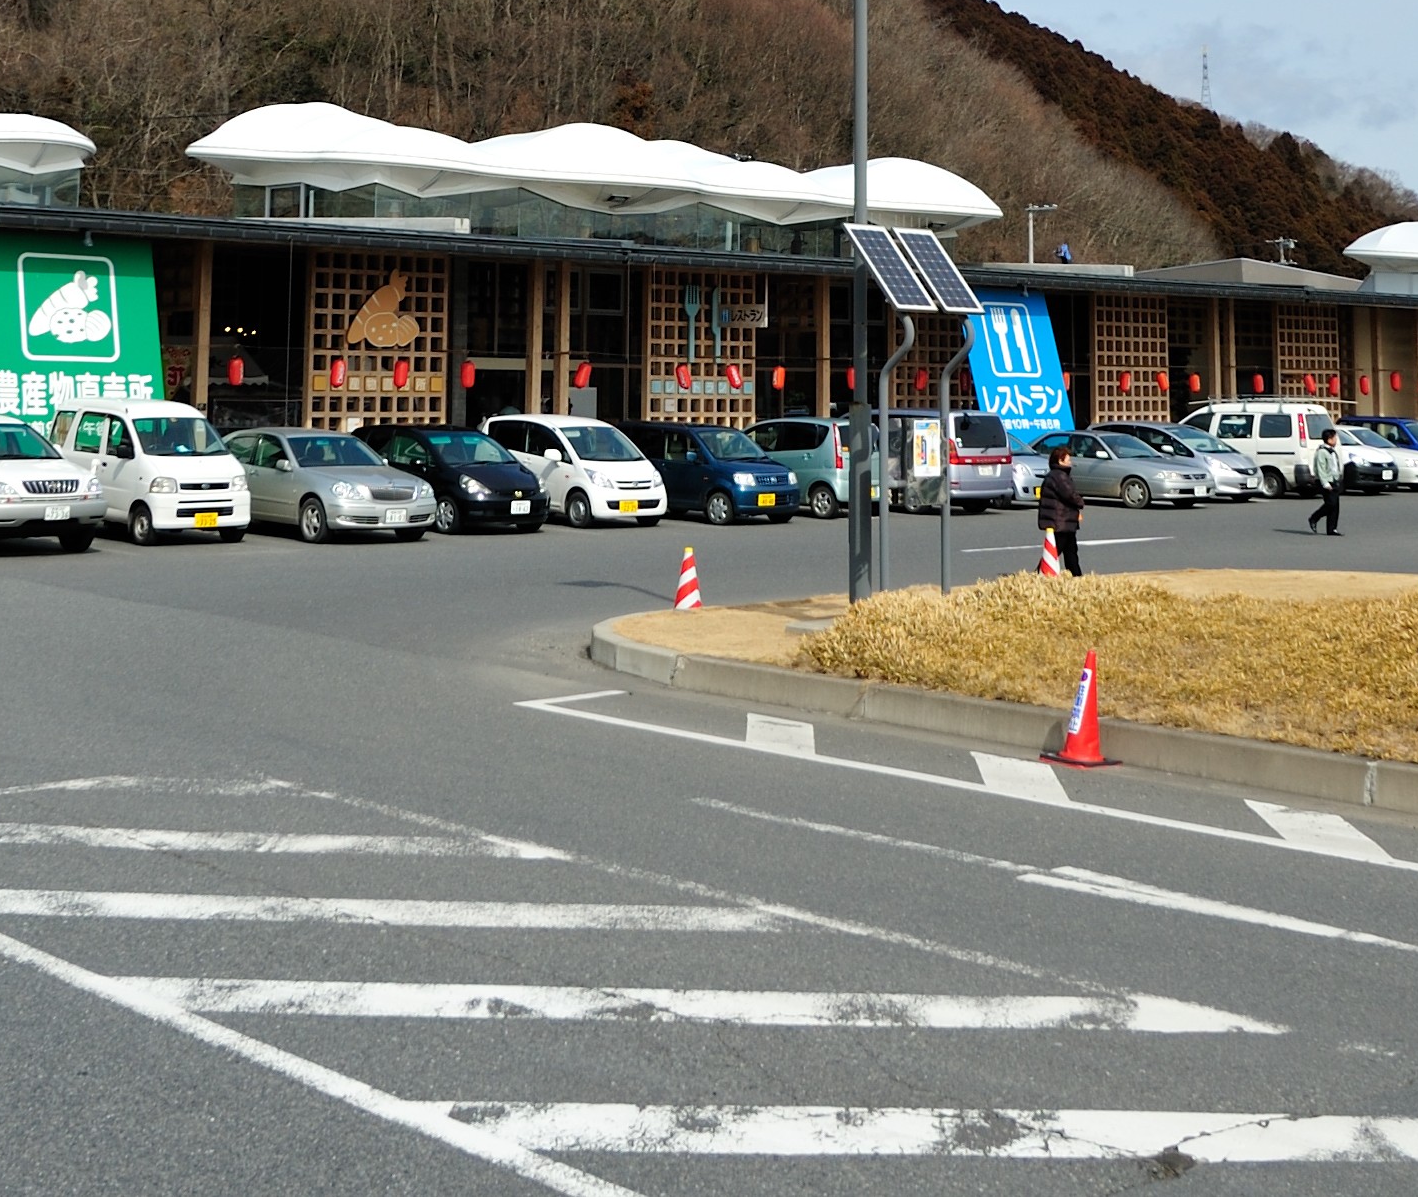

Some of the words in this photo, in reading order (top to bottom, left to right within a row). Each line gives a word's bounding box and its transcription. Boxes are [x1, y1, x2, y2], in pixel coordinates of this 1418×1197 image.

[731, 309, 763, 322] レストラン
[981, 384, 1063, 416] レストラン
